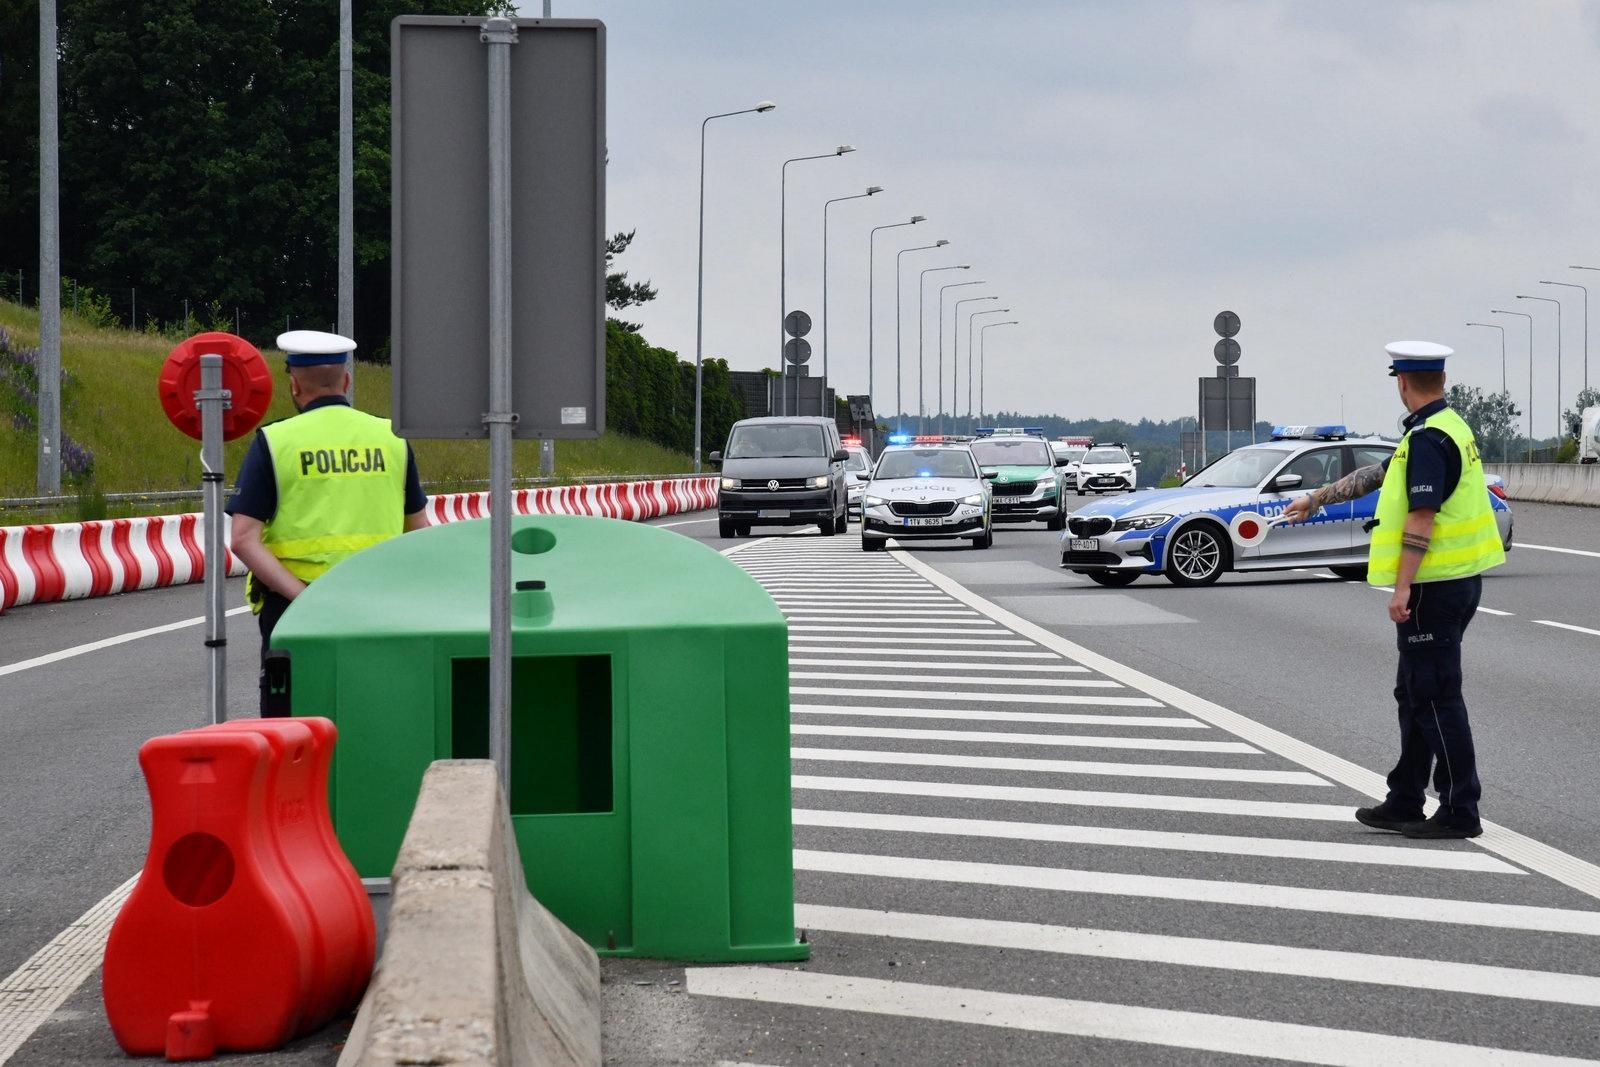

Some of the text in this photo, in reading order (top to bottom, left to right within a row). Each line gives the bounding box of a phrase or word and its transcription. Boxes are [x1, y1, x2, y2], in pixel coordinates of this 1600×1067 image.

[300, 448, 386, 476] POLICJA
[891, 485, 957, 493] POLICIE
[1410, 484, 1433, 494] POLICJA
[909, 518, 940, 526] 1TV 9635
[1408, 633, 1434, 644] POLICJA
